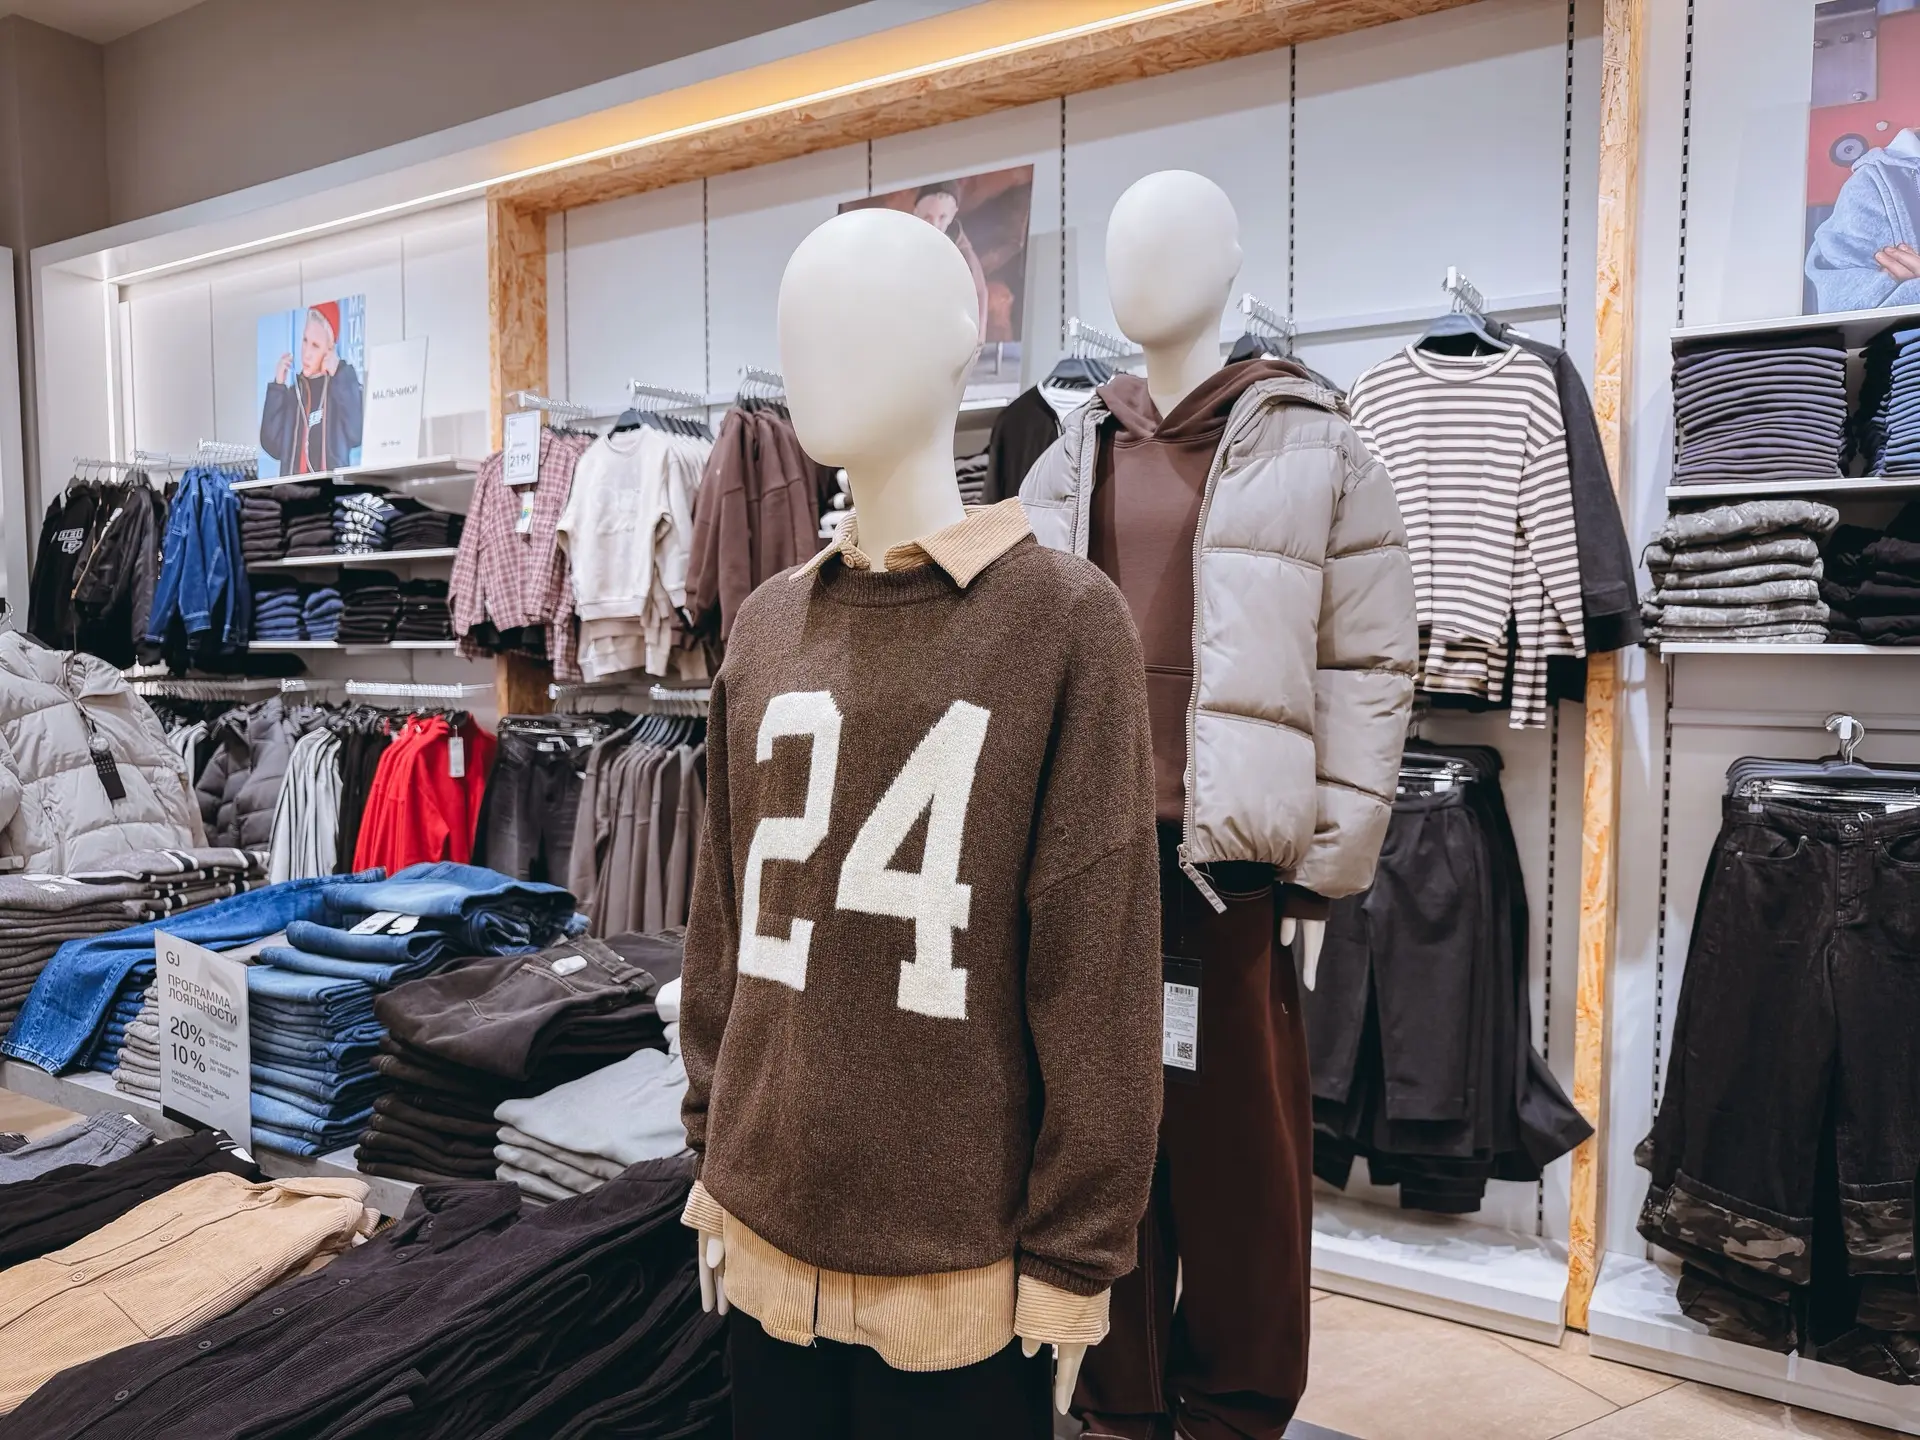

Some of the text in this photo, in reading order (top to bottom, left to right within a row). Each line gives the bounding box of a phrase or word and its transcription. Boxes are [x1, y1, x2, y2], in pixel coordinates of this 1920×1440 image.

[372, 384, 418, 401] МАЛЬЧИКИ
[509, 453, 532, 468] 2199
[738, 690, 991, 1021] 24
[166, 950, 180, 967] GJ
[167, 974, 231, 1010] ПРОГРАММА
[168, 987, 238, 1027] ЛОЯЛЬНОСТИ
[170, 1016, 206, 1048] 20%
[171, 1043, 206, 1073] 10%
[171, 1069, 202, 1087] НАЧИСЛЯЕМ
[202, 1081, 210, 1091] ЗА
[209, 1085, 230, 1100] ТОВАРЫ
[171, 1076, 180, 1085] ПО
[179, 1080, 201, 1095] ПОЛНОЙ
